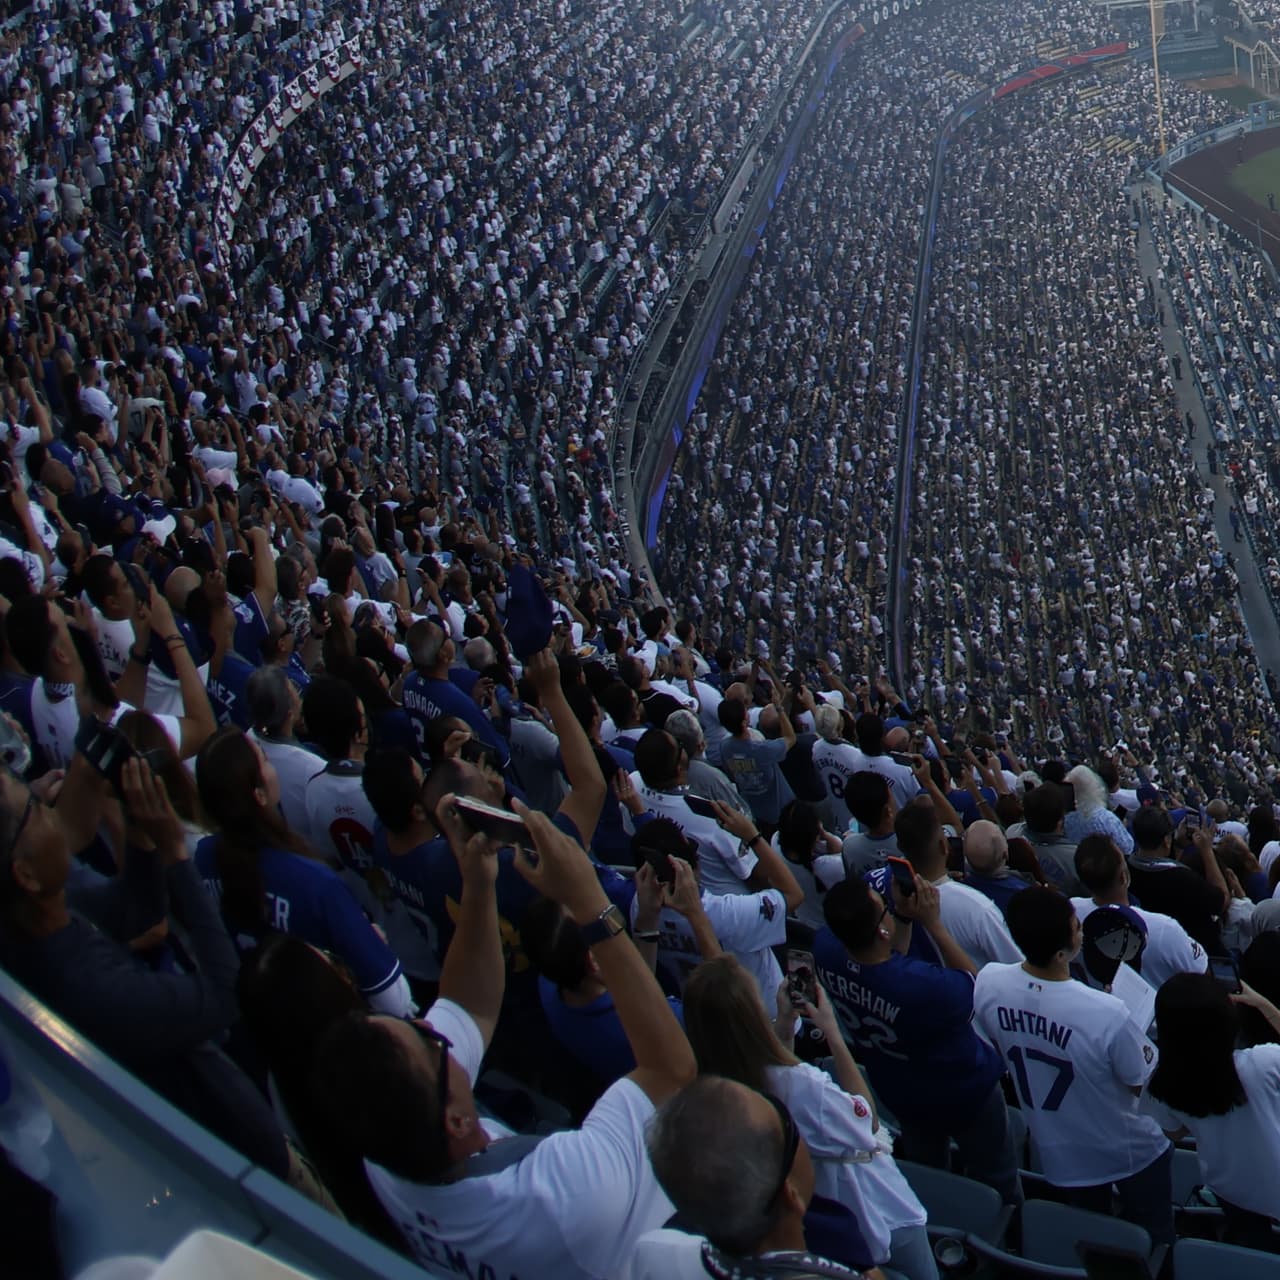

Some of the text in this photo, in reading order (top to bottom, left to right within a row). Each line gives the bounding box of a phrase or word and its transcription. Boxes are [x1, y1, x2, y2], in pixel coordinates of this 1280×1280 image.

[828, 773, 845, 799] 8
[815, 965, 902, 1025] KERSHAW
[997, 1005, 1073, 1051] OHTANI
[1007, 1044, 1075, 1112] 17
